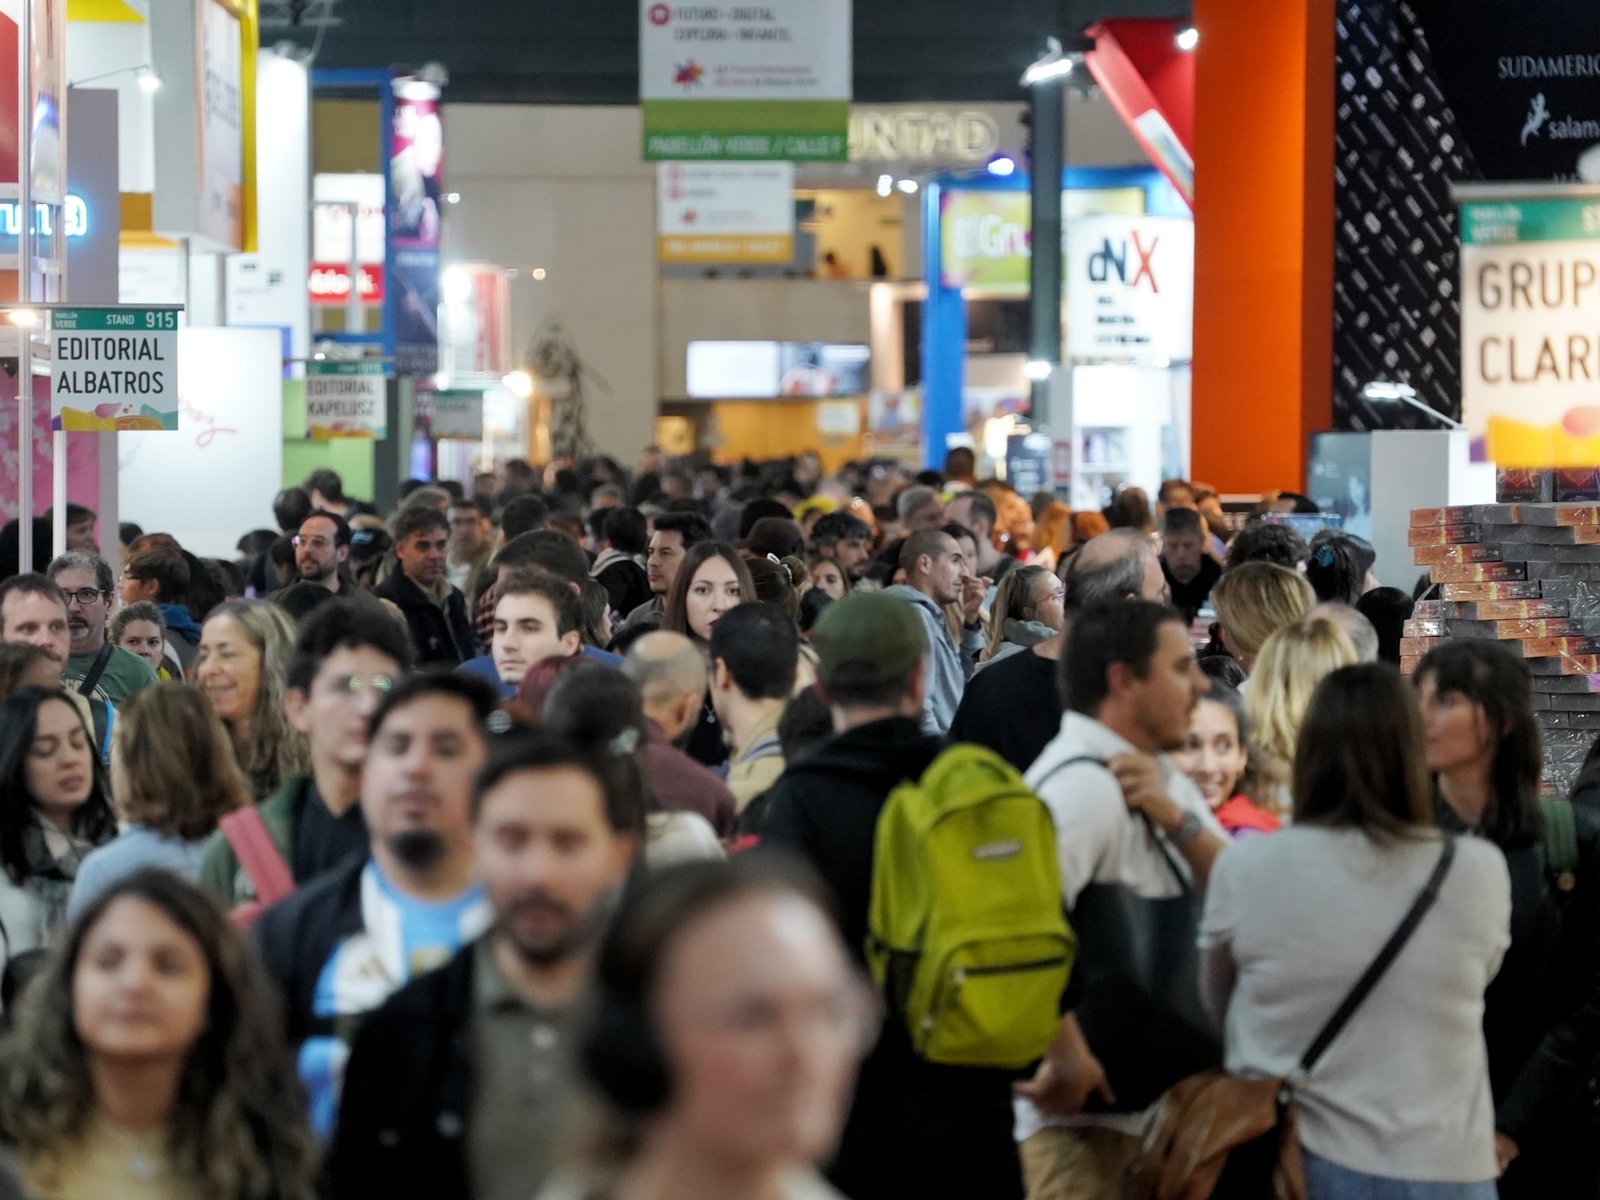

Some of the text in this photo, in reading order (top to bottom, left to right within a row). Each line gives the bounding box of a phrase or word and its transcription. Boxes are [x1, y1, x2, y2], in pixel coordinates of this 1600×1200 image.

[55, 319, 77, 328] VERDE
[106, 312, 174, 328] STAND 915
[58, 337, 164, 360] EDITORIAL
[57, 370, 164, 395] ALBATROS
[307, 379, 376, 396] EDITORIAL
[308, 399, 376, 416] KAPELUSZ
